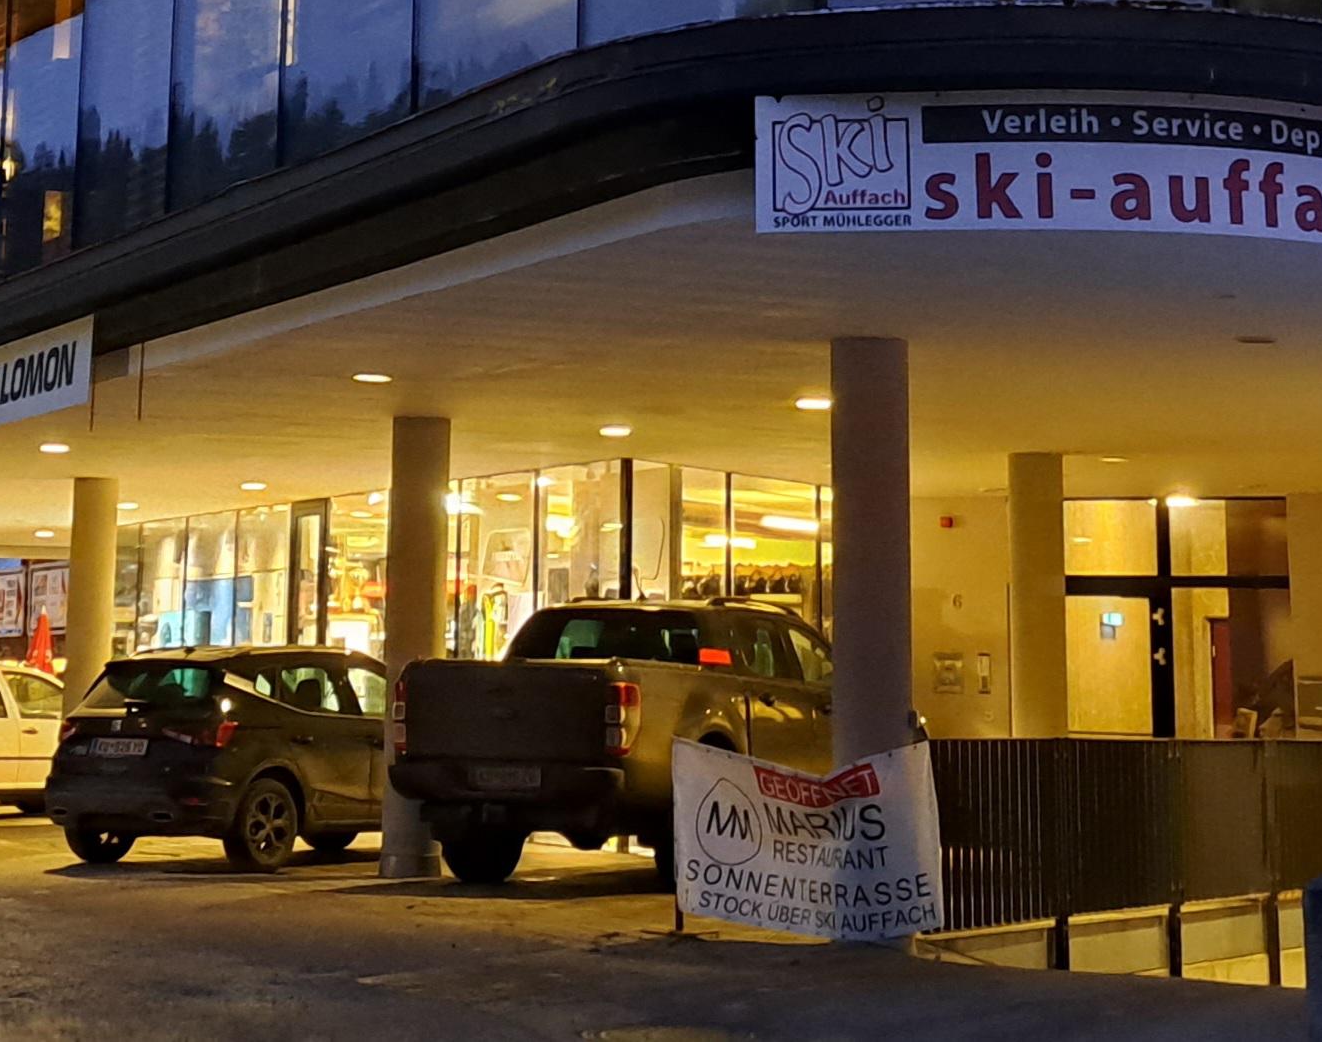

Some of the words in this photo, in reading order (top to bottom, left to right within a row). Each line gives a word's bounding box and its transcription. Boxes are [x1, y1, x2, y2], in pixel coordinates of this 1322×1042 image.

[981, 109, 1100, 135] Verleih
[1132, 110, 1244, 141] Service
[779, 96, 894, 215] Ski
[823, 189, 907, 207] Auffach
[773, 213, 817, 228] SPORT
[822, 213, 912, 228] MÜHLEGGER
[952, 593, 963, 609] 6
[706, 801, 754, 842] MM
[764, 803, 886, 841] MARIUS
[773, 839, 888, 870] RESTAURANT
[685, 859, 931, 908] SONNENTERRASSE
[699, 891, 761, 919] STOCK
[815, 911, 835, 930] SKI
[841, 902, 937, 931] AUFFACH
